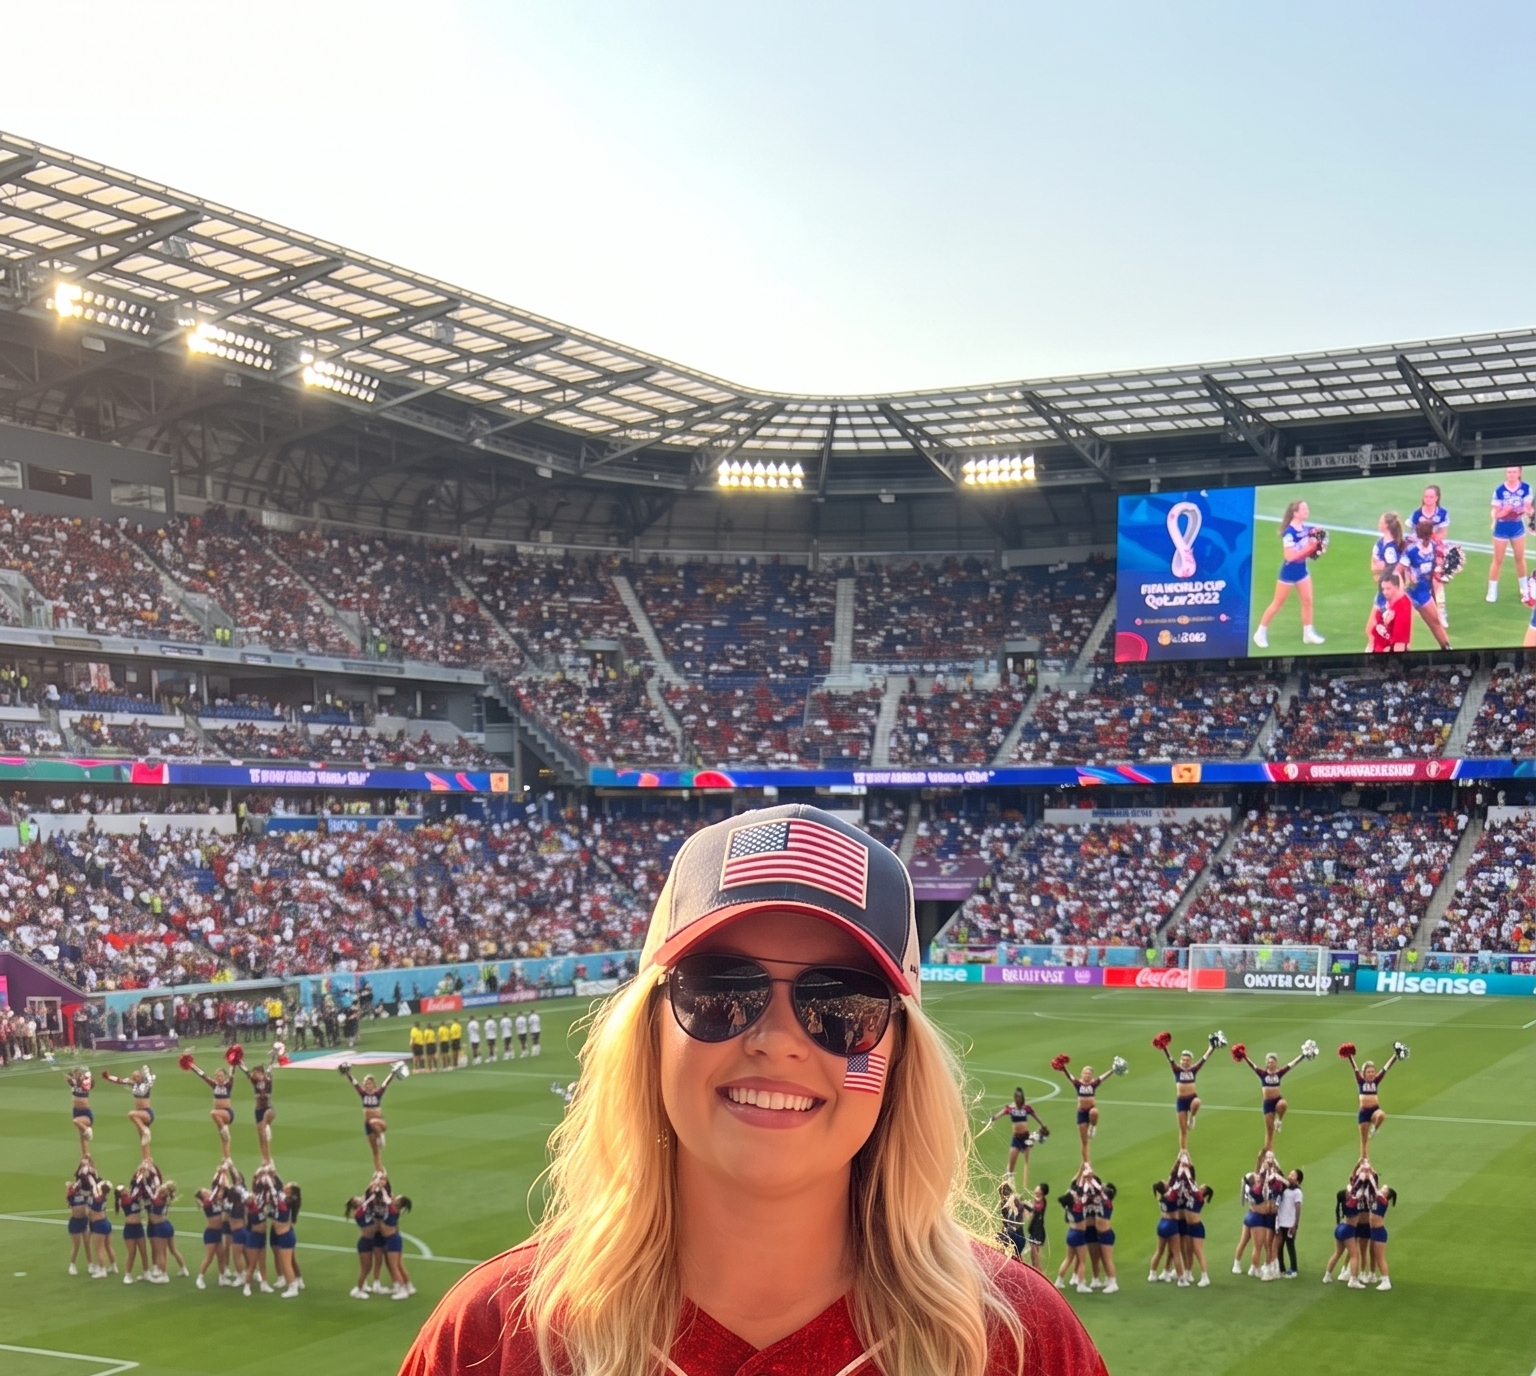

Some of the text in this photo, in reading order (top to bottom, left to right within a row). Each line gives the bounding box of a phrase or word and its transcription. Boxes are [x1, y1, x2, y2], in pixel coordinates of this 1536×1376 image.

[1203, 580, 1227, 592] CUP
[1186, 592, 1220, 606] 2022
[920, 967, 968, 982] ense
[1376, 971, 1487, 995] Hisense
